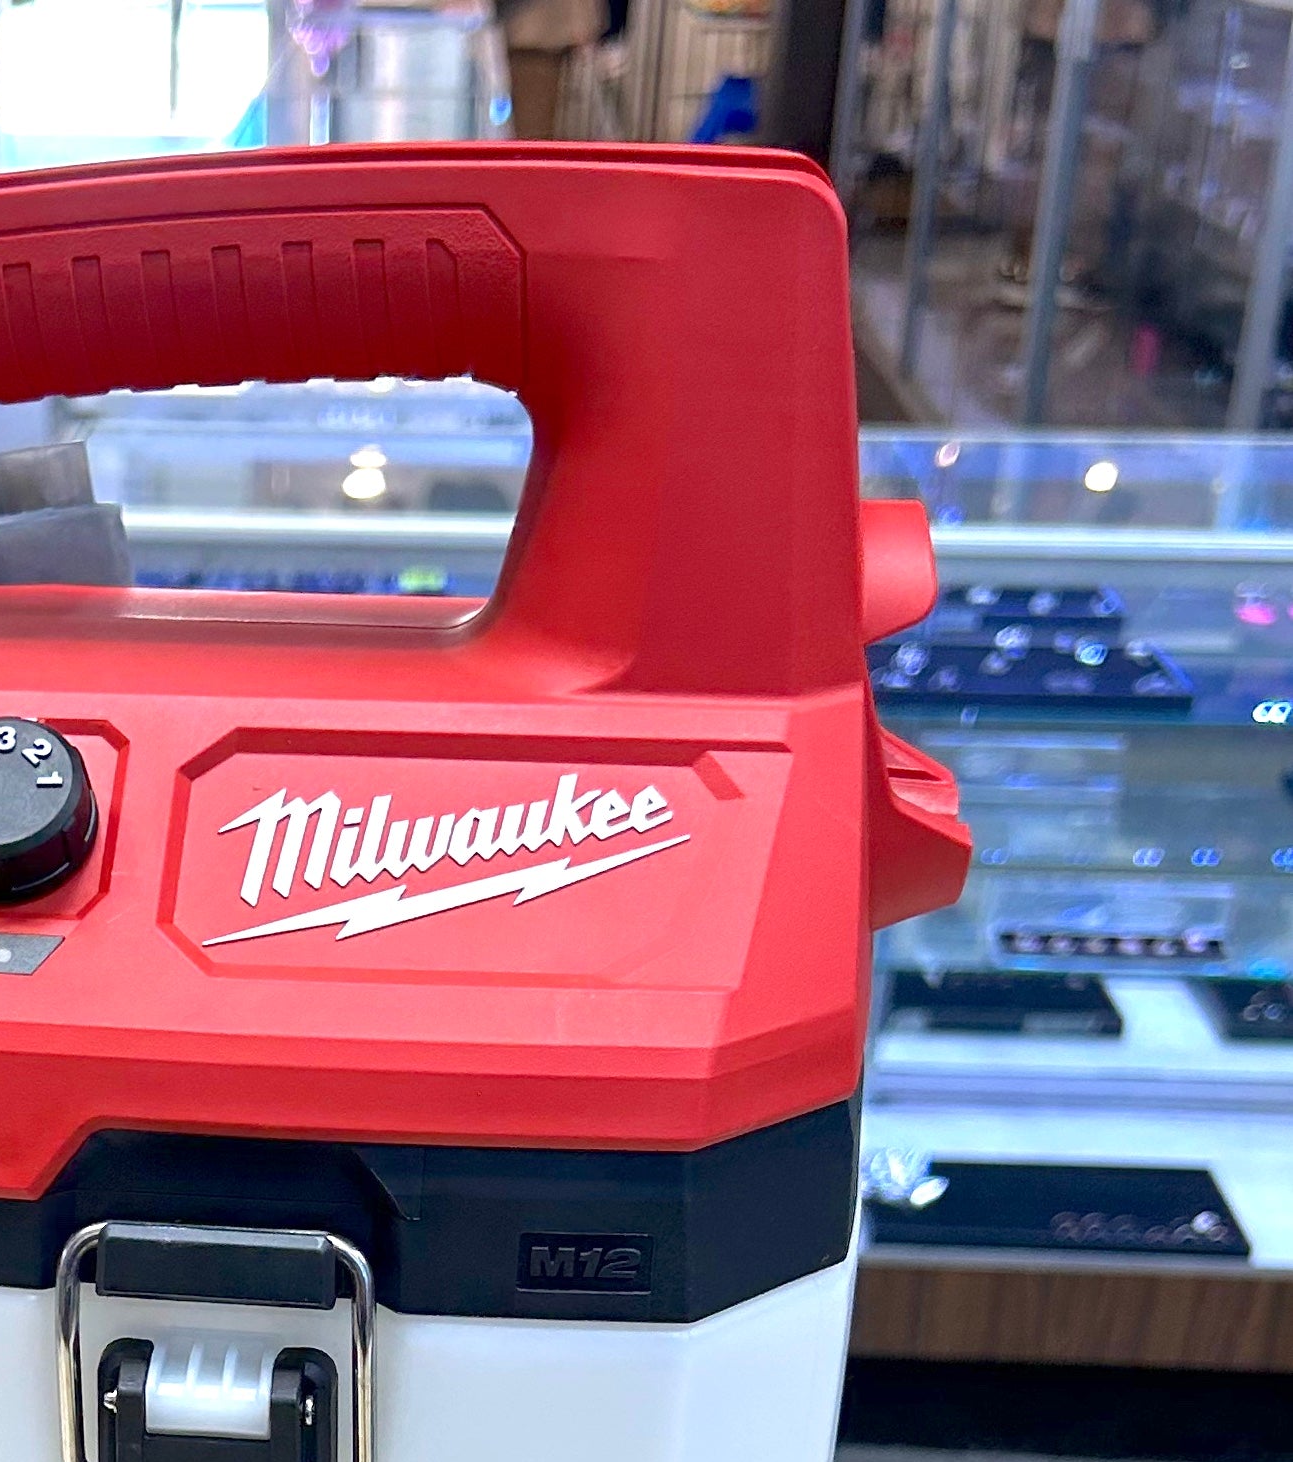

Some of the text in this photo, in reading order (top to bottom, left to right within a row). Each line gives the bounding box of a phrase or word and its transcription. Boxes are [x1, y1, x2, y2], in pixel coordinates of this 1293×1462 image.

[22, 738, 53, 768] 2
[36, 771, 64, 788] 1
[218, 773, 674, 907] Milwaukee
[530, 1246, 642, 1279] M12
